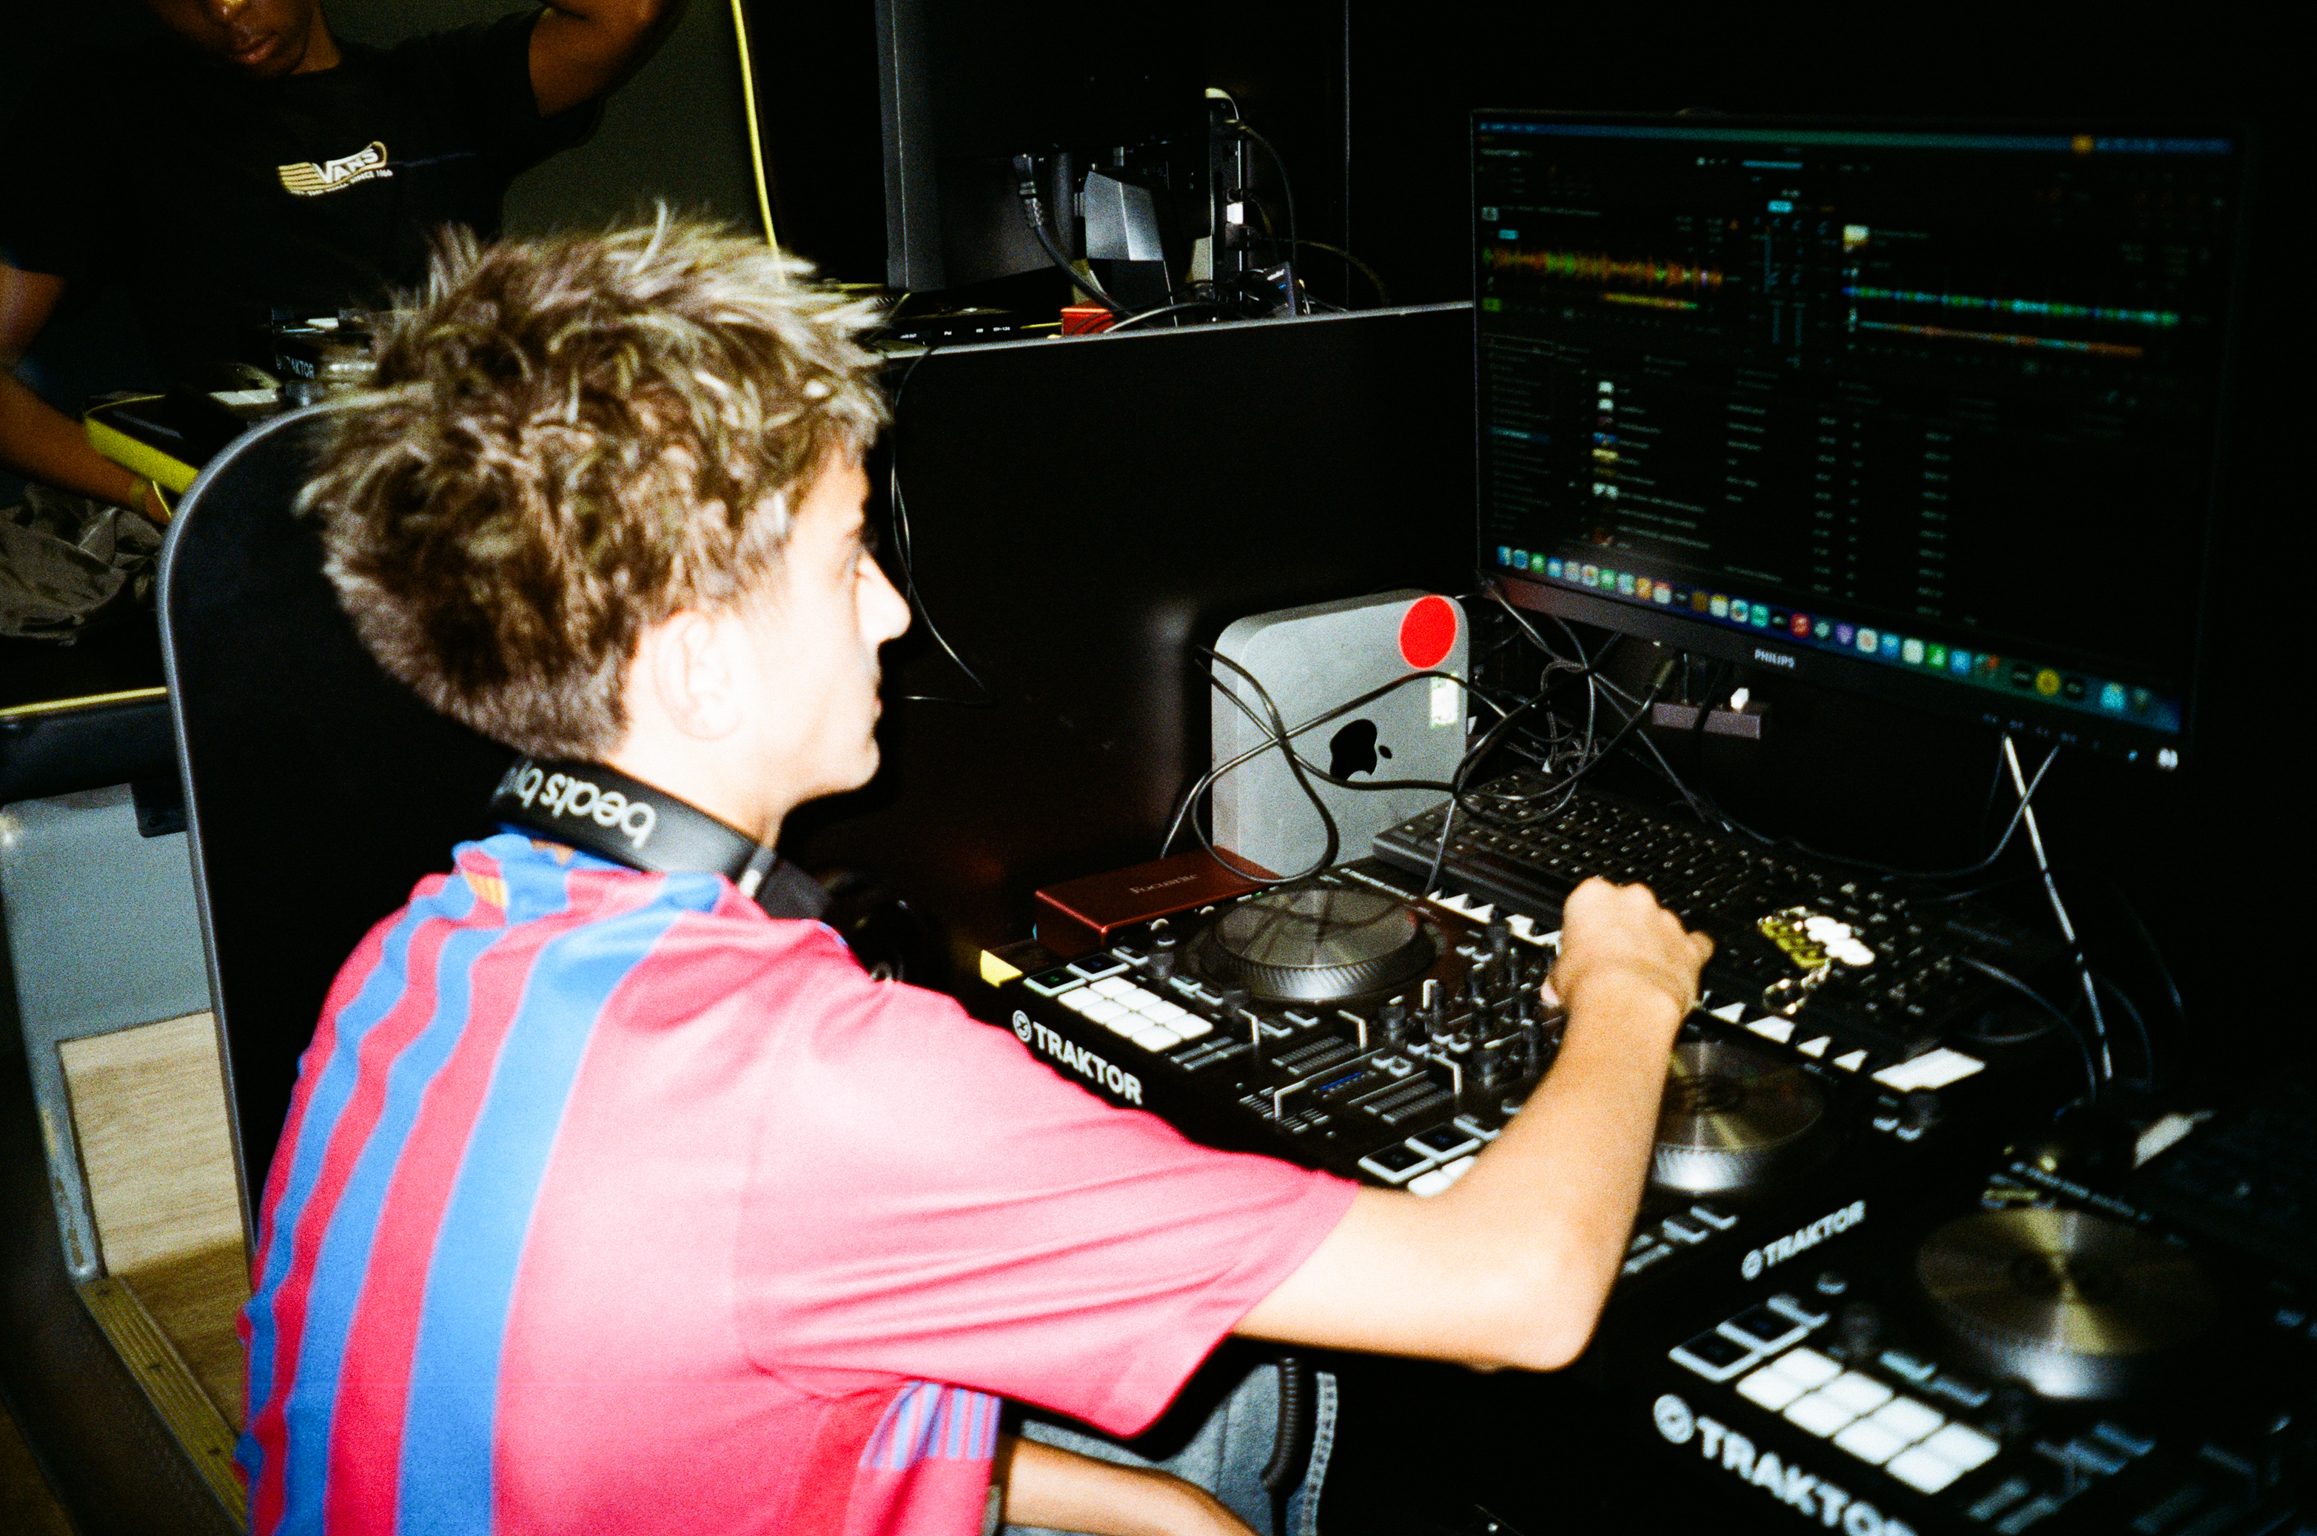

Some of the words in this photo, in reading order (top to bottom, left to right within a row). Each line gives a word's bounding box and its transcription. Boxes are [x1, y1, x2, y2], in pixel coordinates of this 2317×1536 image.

[312, 145, 379, 184] VANS
[283, 355, 315, 379] AKTOR
[1754, 647, 1796, 669] PHILIPS
[539, 772, 657, 849] beats
[1032, 1021, 1143, 1106] TRAKTOR
[1762, 1199, 1866, 1268] TRAKTOR
